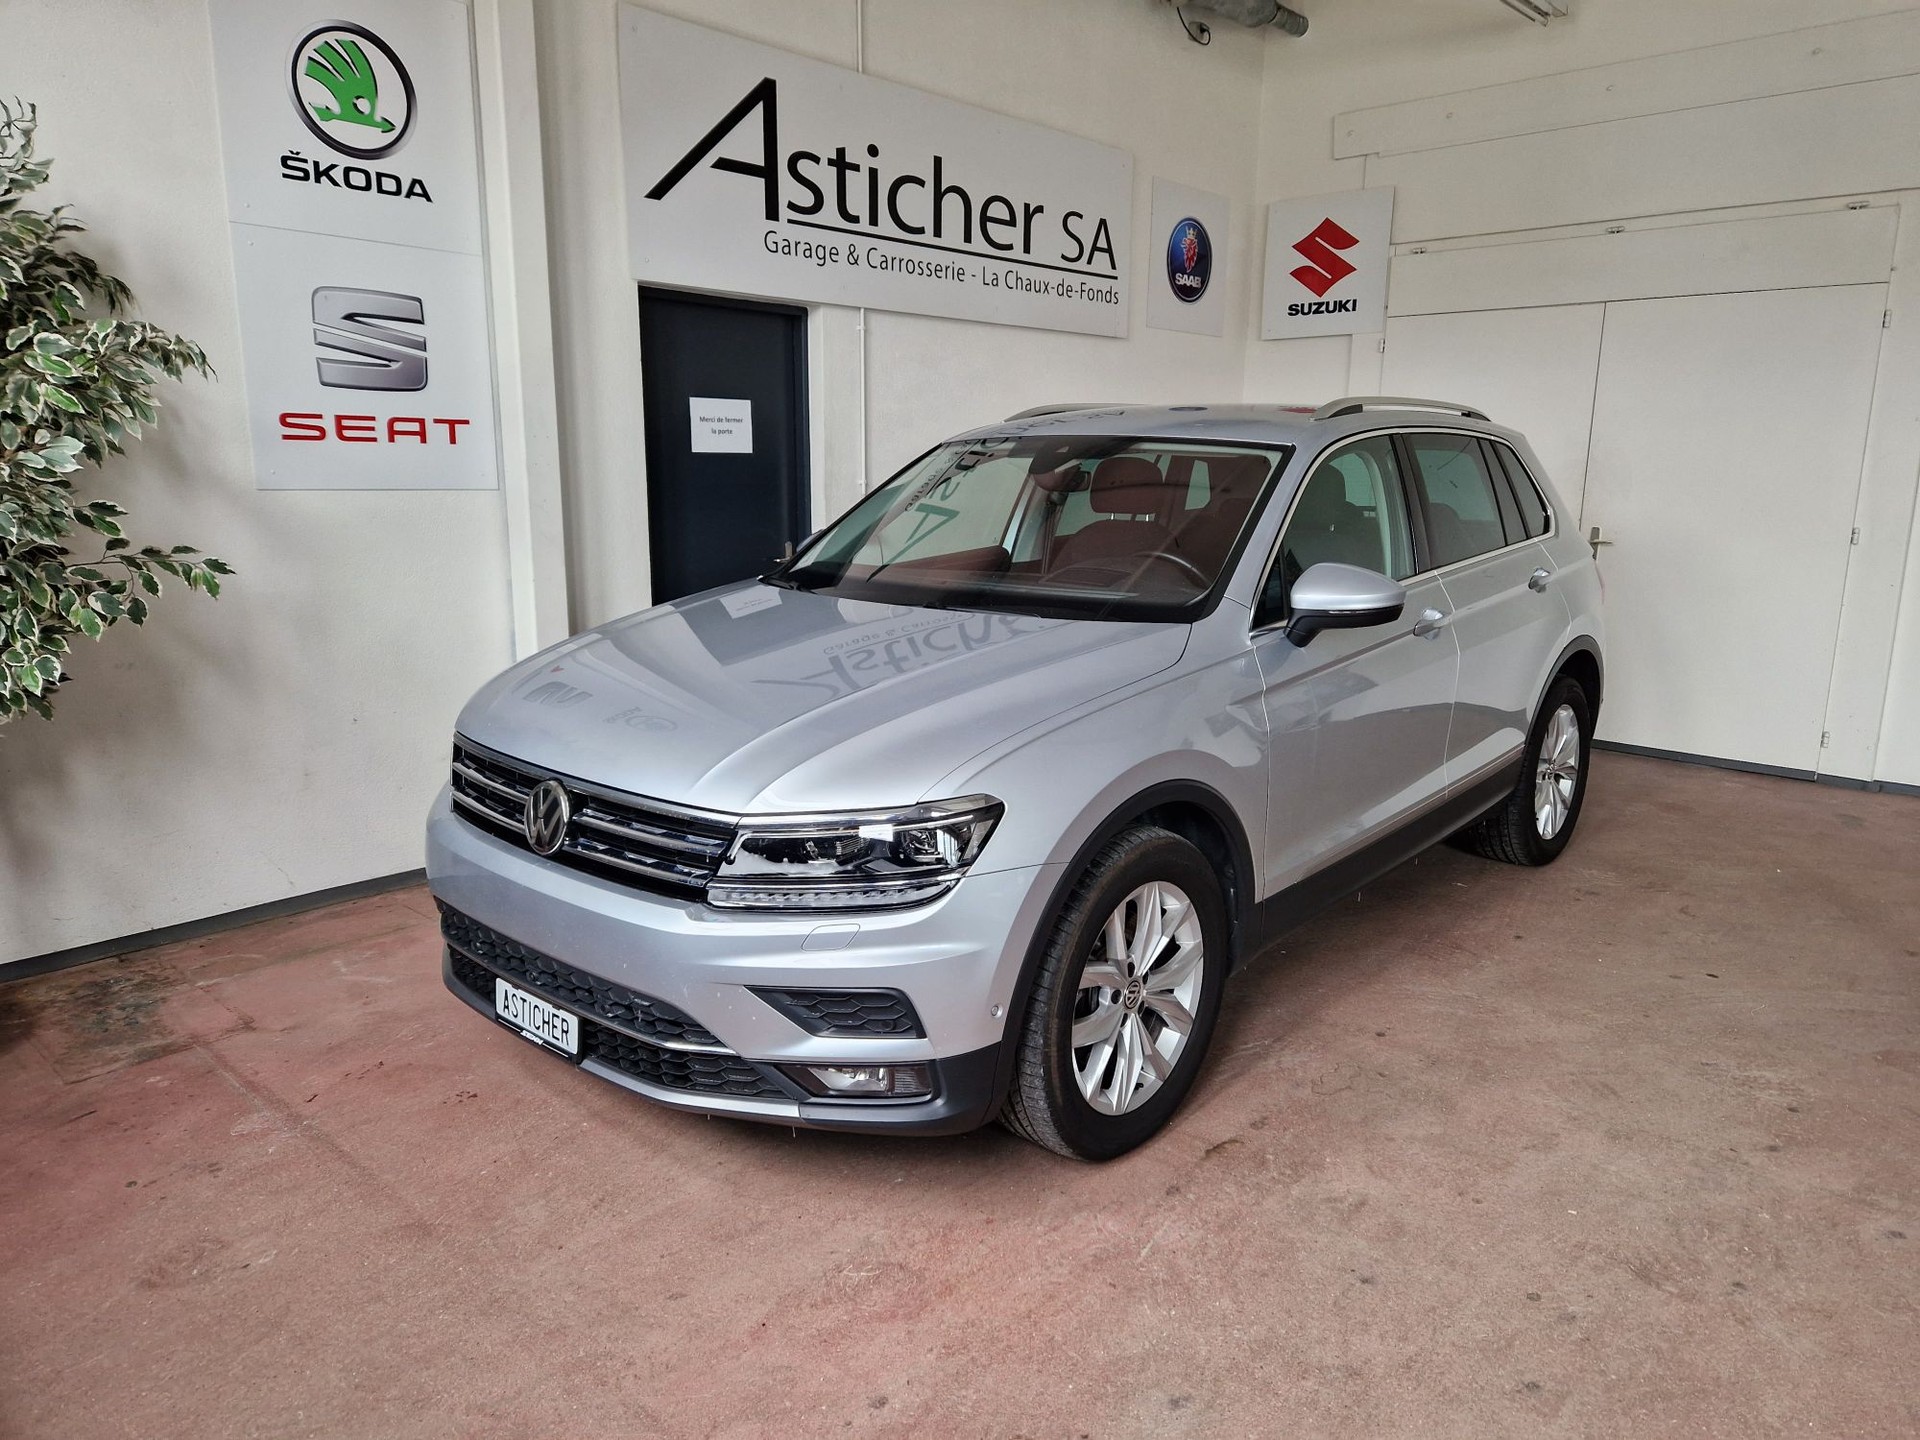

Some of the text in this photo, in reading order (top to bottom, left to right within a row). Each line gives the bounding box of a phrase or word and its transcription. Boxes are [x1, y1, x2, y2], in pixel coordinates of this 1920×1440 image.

[280, 150, 433, 202] ŠKODA
[644, 77, 1117, 270] Asticher SA
[764, 230, 840, 267] Garage
[846, 243, 860, 266] &
[866, 247, 965, 282] Carrosserie
[982, 266, 999, 287] La
[1004, 270, 1120, 305] Chaux-de-Fonds
[1174, 273, 1202, 288] SAAB
[1287, 298, 1358, 317] SUZUKI
[279, 412, 470, 445] SEAT
[699, 415, 743, 424] Merci de fermer
[717, 428, 733, 436] porte
[503, 988, 570, 1047] ASTICHER
